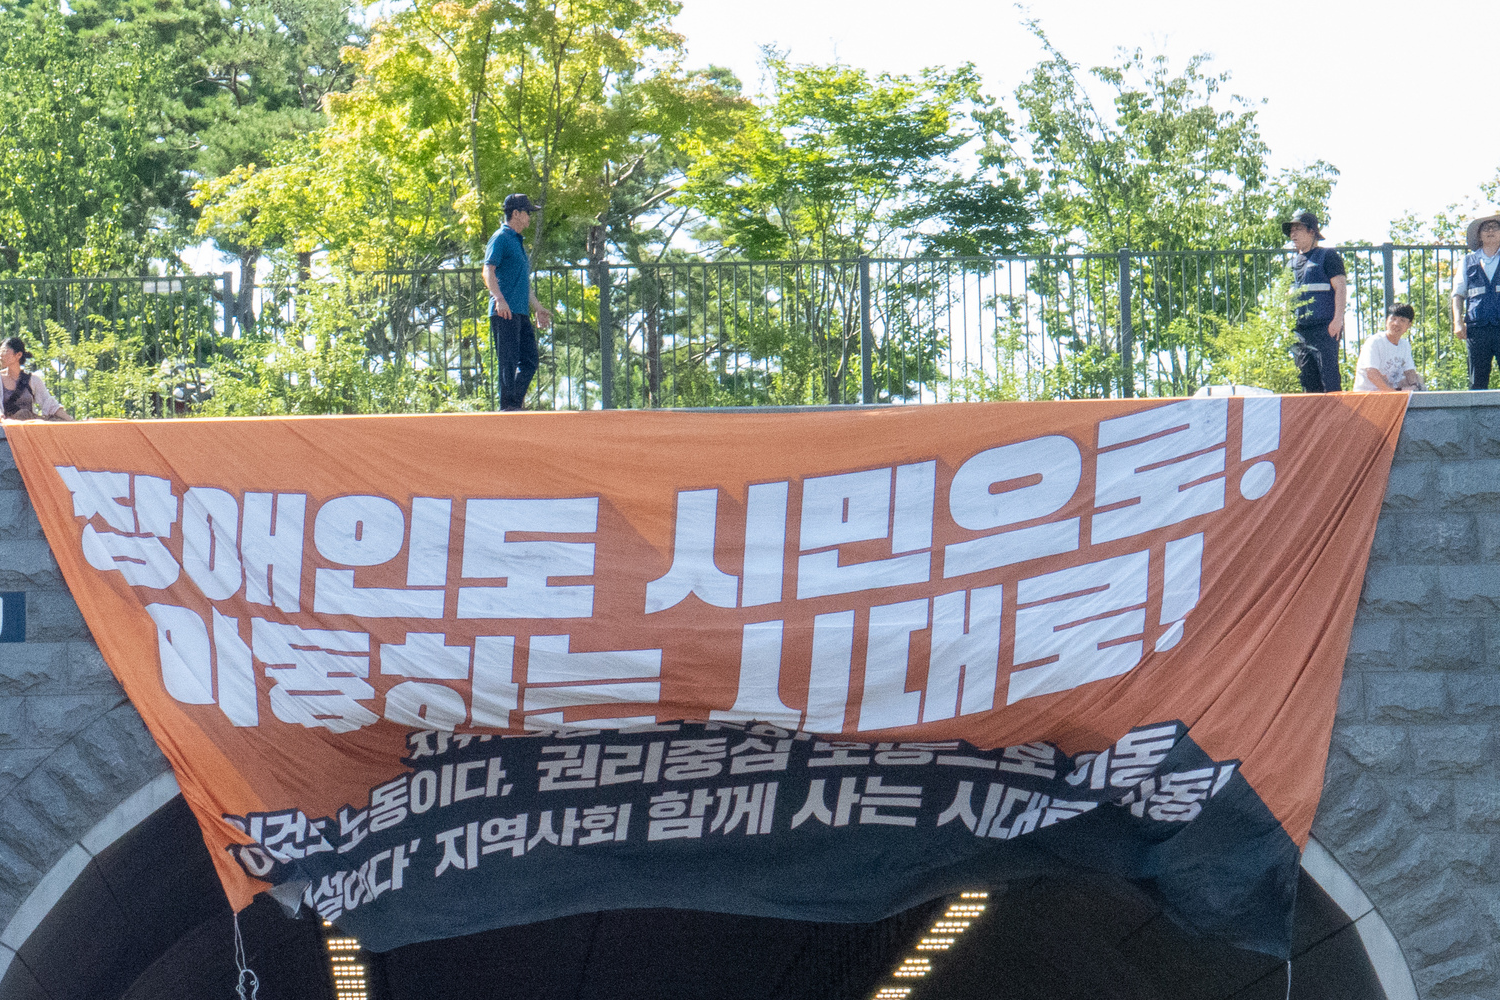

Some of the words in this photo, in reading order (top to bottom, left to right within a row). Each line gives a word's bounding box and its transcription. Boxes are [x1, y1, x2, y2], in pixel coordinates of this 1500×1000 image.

[54, 465, 600, 620] 장애인도
[645, 395, 1282, 616] 시민으로!
[145, 602, 664, 736] 이동하는
[708, 532, 1206, 735] 시대로!
[435, 803, 632, 878] 지역사회
[648, 781, 779, 842] 함께
[791, 776, 923, 829] 사는
[537, 737, 793, 792] 권리중심
